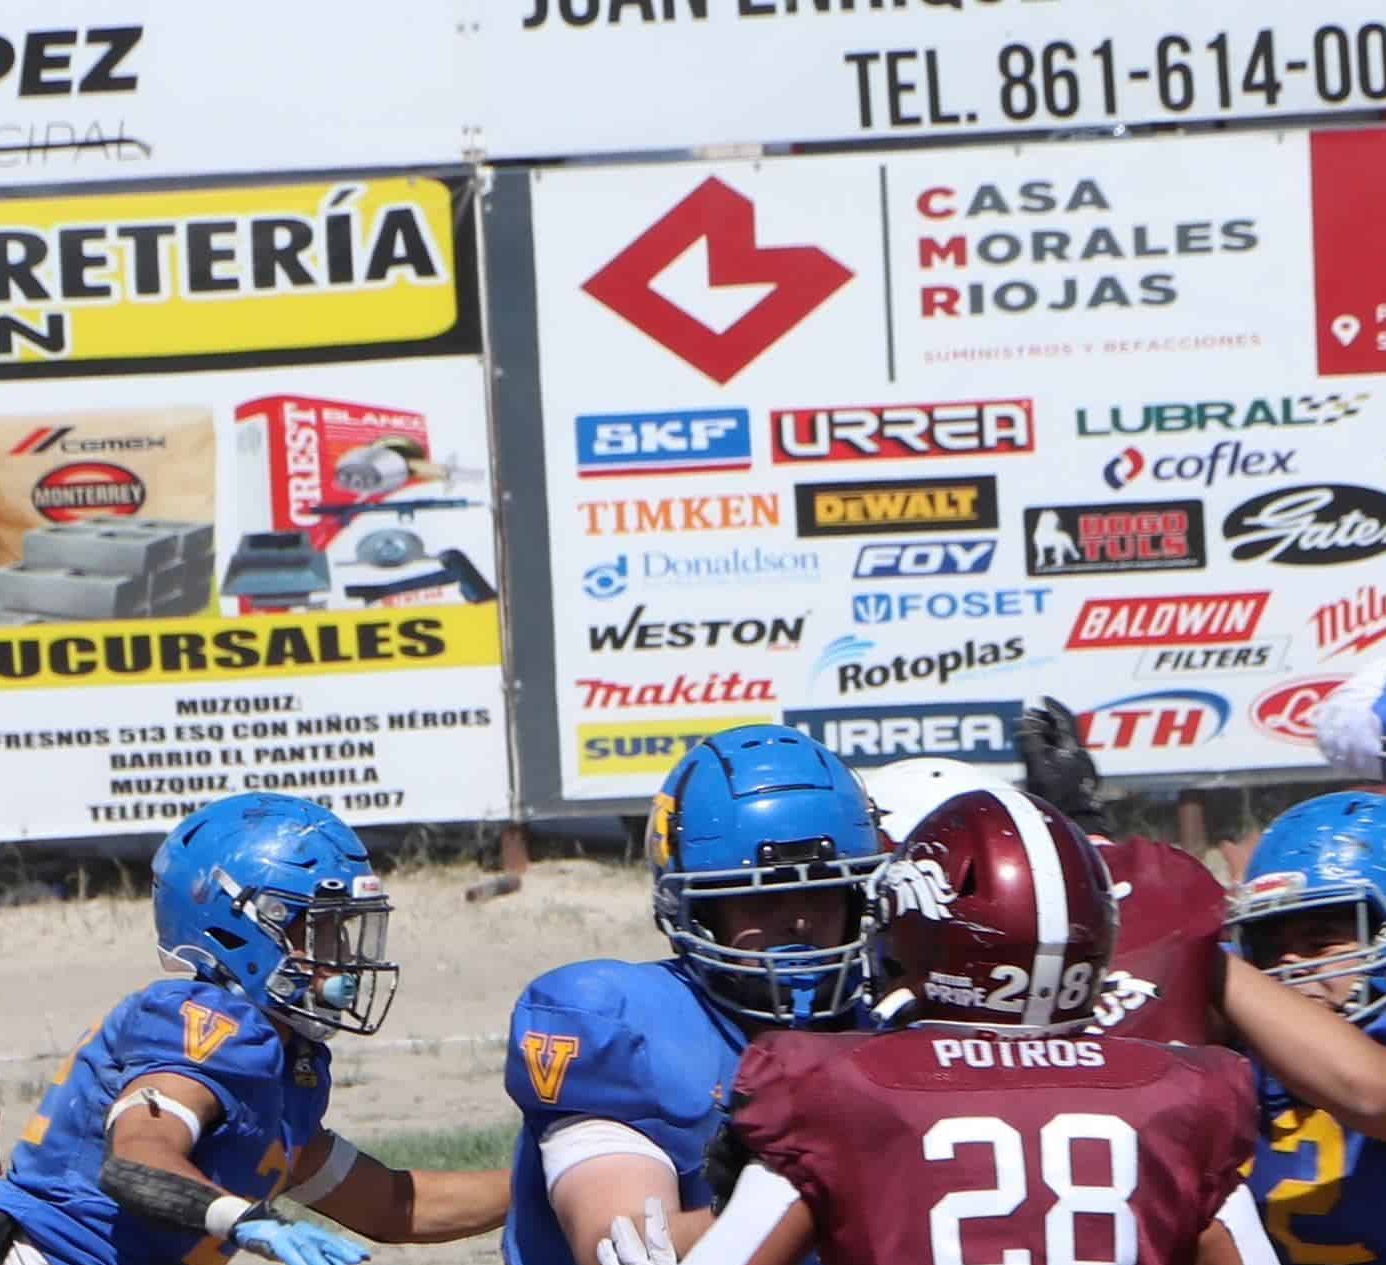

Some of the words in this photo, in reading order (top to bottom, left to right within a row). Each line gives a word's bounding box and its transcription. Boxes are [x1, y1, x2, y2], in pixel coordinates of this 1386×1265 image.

[846, 50, 979, 129] TEL.
[916, 179, 1111, 219] CASA
[918, 219, 1261, 268] MORALES
[921, 273, 1178, 318] RIOJAS
[923, 342, 1073, 364] SUMINISTROS
[593, 416, 738, 456] SKF
[779, 403, 1030, 457] URREA
[1076, 396, 1313, 437] LUBRAL
[1152, 441, 1297, 487] coflex
[577, 493, 781, 536] TIMKEN
[643, 548, 820, 579] Donaldson
[858, 543, 993, 576] FOY
[899, 587, 1054, 620] FOSET
[1079, 598, 1258, 640] BALDWIN
[589, 604, 805, 651] WESTON
[839, 637, 1025, 694] Rotoplas
[1153, 646, 1274, 671] FILTERS
[118, 725, 167, 745] 513
[175, 723, 225, 743] ESQ
[232, 719, 289, 739] CON
[297, 713, 380, 735] NIÑOS
[388, 707, 492, 731] HÉROES
[1077, 709, 1206, 751] LTH
[110, 750, 213, 771] BARRIO
[220, 747, 248, 766] EL
[254, 740, 377, 764] PANTEÓN
[244, 765, 380, 790] COAHUILA
[343, 790, 406, 811] 1907
[179, 999, 242, 1065] V
[522, 1031, 581, 1105] V
